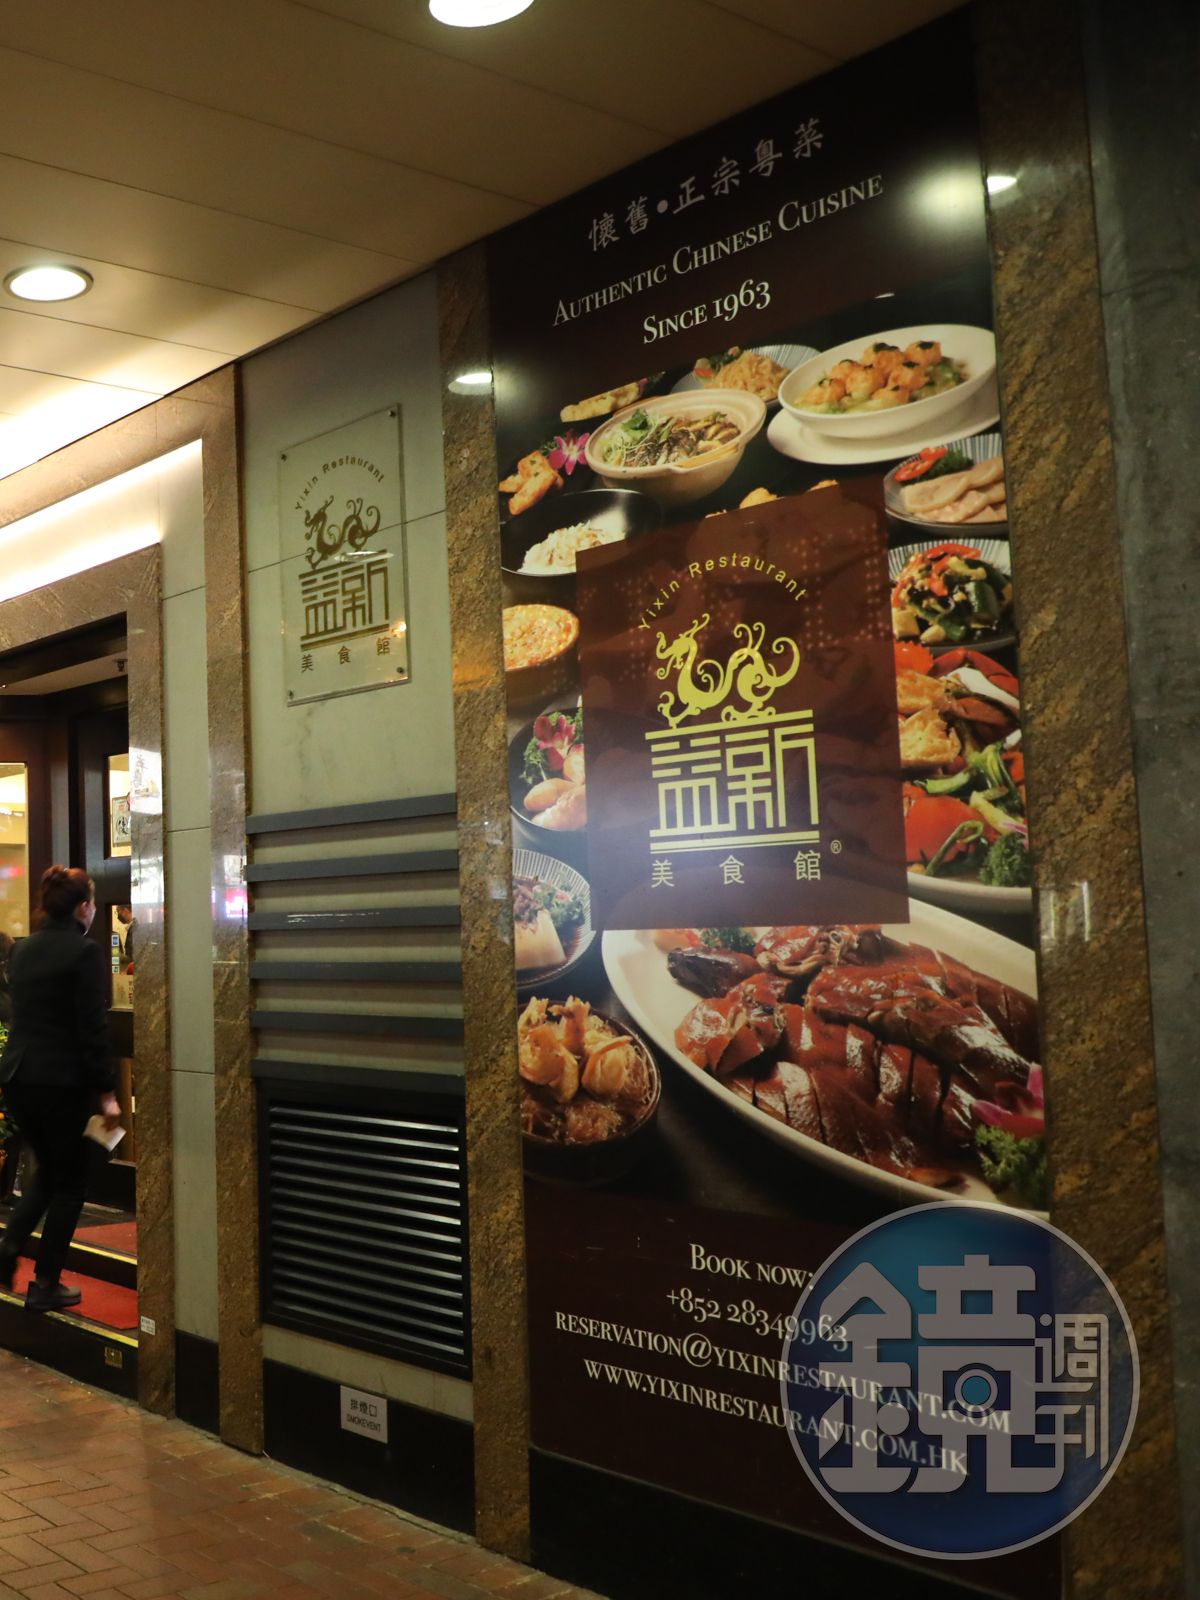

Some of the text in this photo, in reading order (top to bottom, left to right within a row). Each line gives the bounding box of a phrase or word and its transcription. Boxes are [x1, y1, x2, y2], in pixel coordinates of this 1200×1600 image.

[552, 173, 884, 327] AUTHENTIC CHINESE CUISINE
[643, 278, 772, 345] SINCE 1963
[321, 454, 385, 484] Restaurant
[638, 552, 807, 632] Yixin Restaurant
[300, 636, 392, 674] 美食館
[650, 849, 822, 889] 美食館
[666, 1286, 848, 1353] +852 28349963
